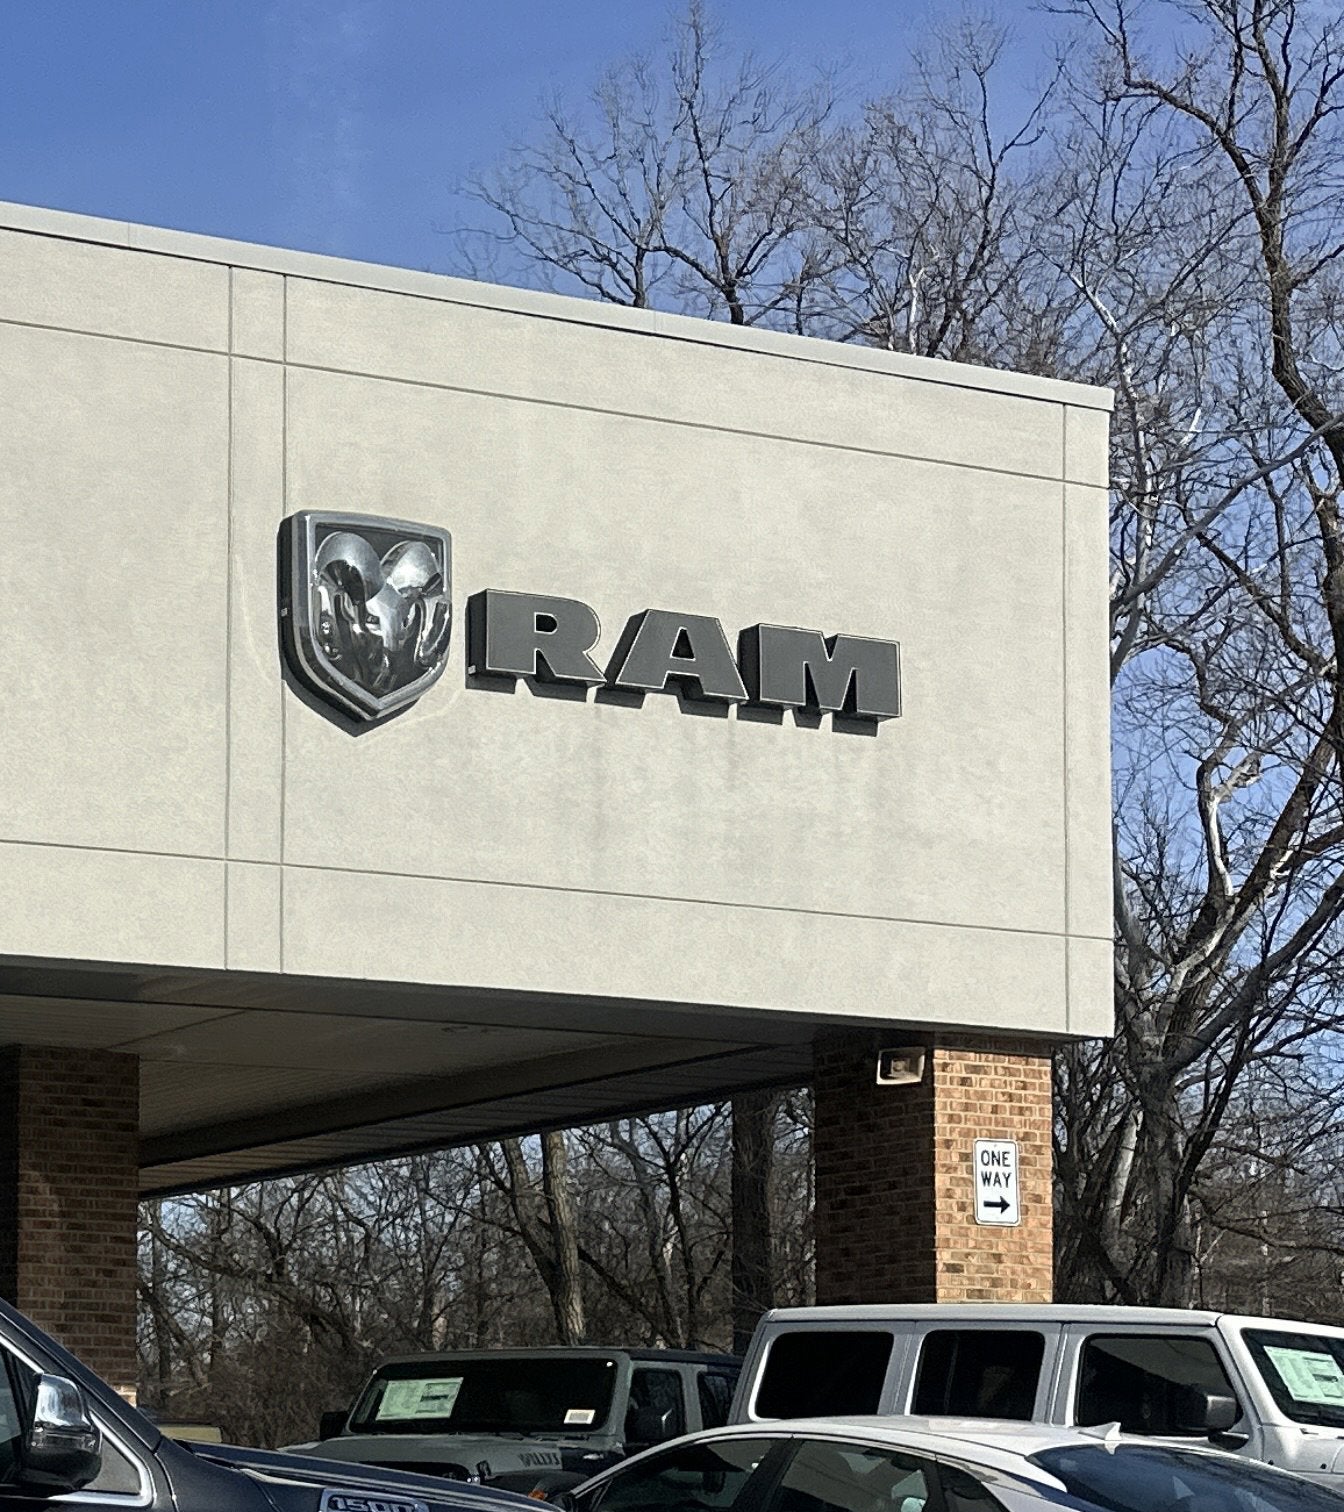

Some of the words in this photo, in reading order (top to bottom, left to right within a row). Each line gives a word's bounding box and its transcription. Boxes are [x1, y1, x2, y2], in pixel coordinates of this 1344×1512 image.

[465, 588, 901, 720] RAM
[980, 1149, 1011, 1167] ONE
[980, 1170, 1012, 1188] WAY
